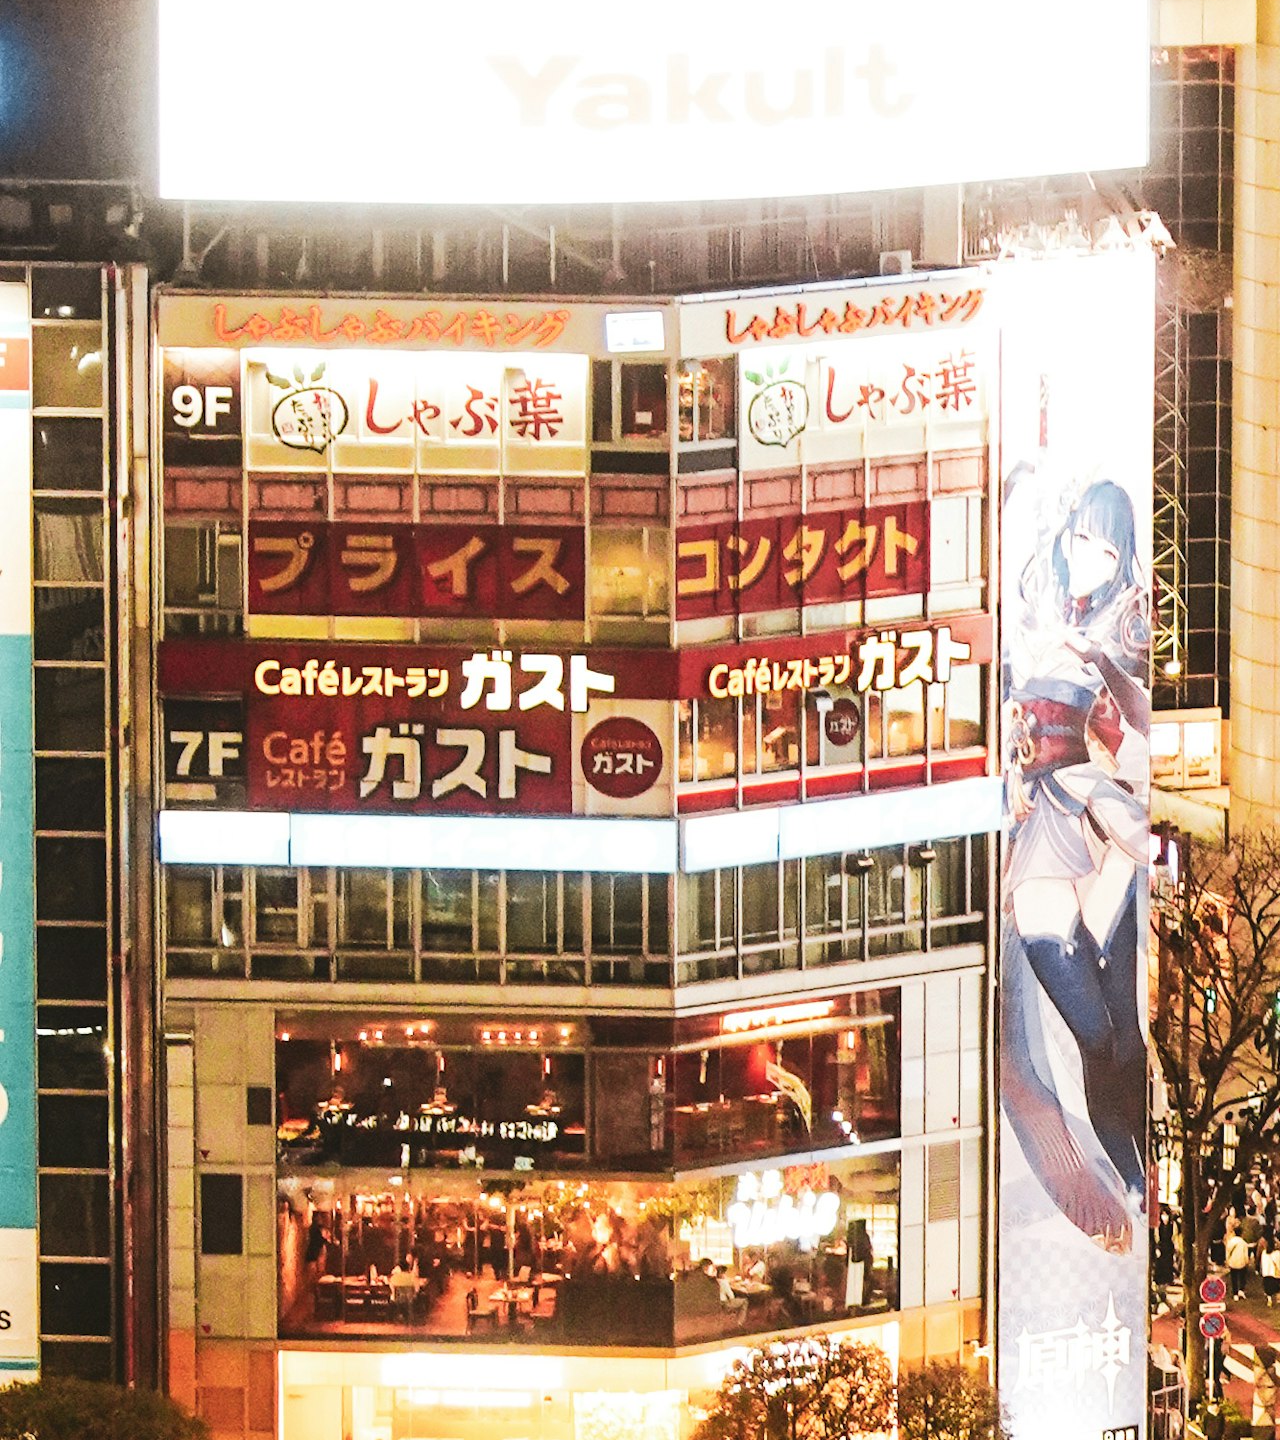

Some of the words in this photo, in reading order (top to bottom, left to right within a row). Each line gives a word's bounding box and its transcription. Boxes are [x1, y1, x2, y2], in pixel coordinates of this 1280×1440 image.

[485, 43, 916, 131] Yakult
[214, 304, 571, 348] しゃぶしゃぶバイキング
[724, 288, 988, 345] しゃぶしゃぶバイキング
[172, 385, 233, 427] 9F
[366, 376, 565, 441] しゃぶ葉
[826, 350, 977, 425] しゃぶ葉
[254, 532, 571, 597] プライス
[678, 515, 918, 595] コンタクト
[459, 649, 616, 713] ガスト
[856, 626, 971, 693] ガスト
[169, 731, 243, 776] 7F
[262, 730, 347, 765] Café
[266, 768, 346, 790] レストラン
[359, 724, 552, 800] ガスト
[591, 752, 655, 776] ガスト
